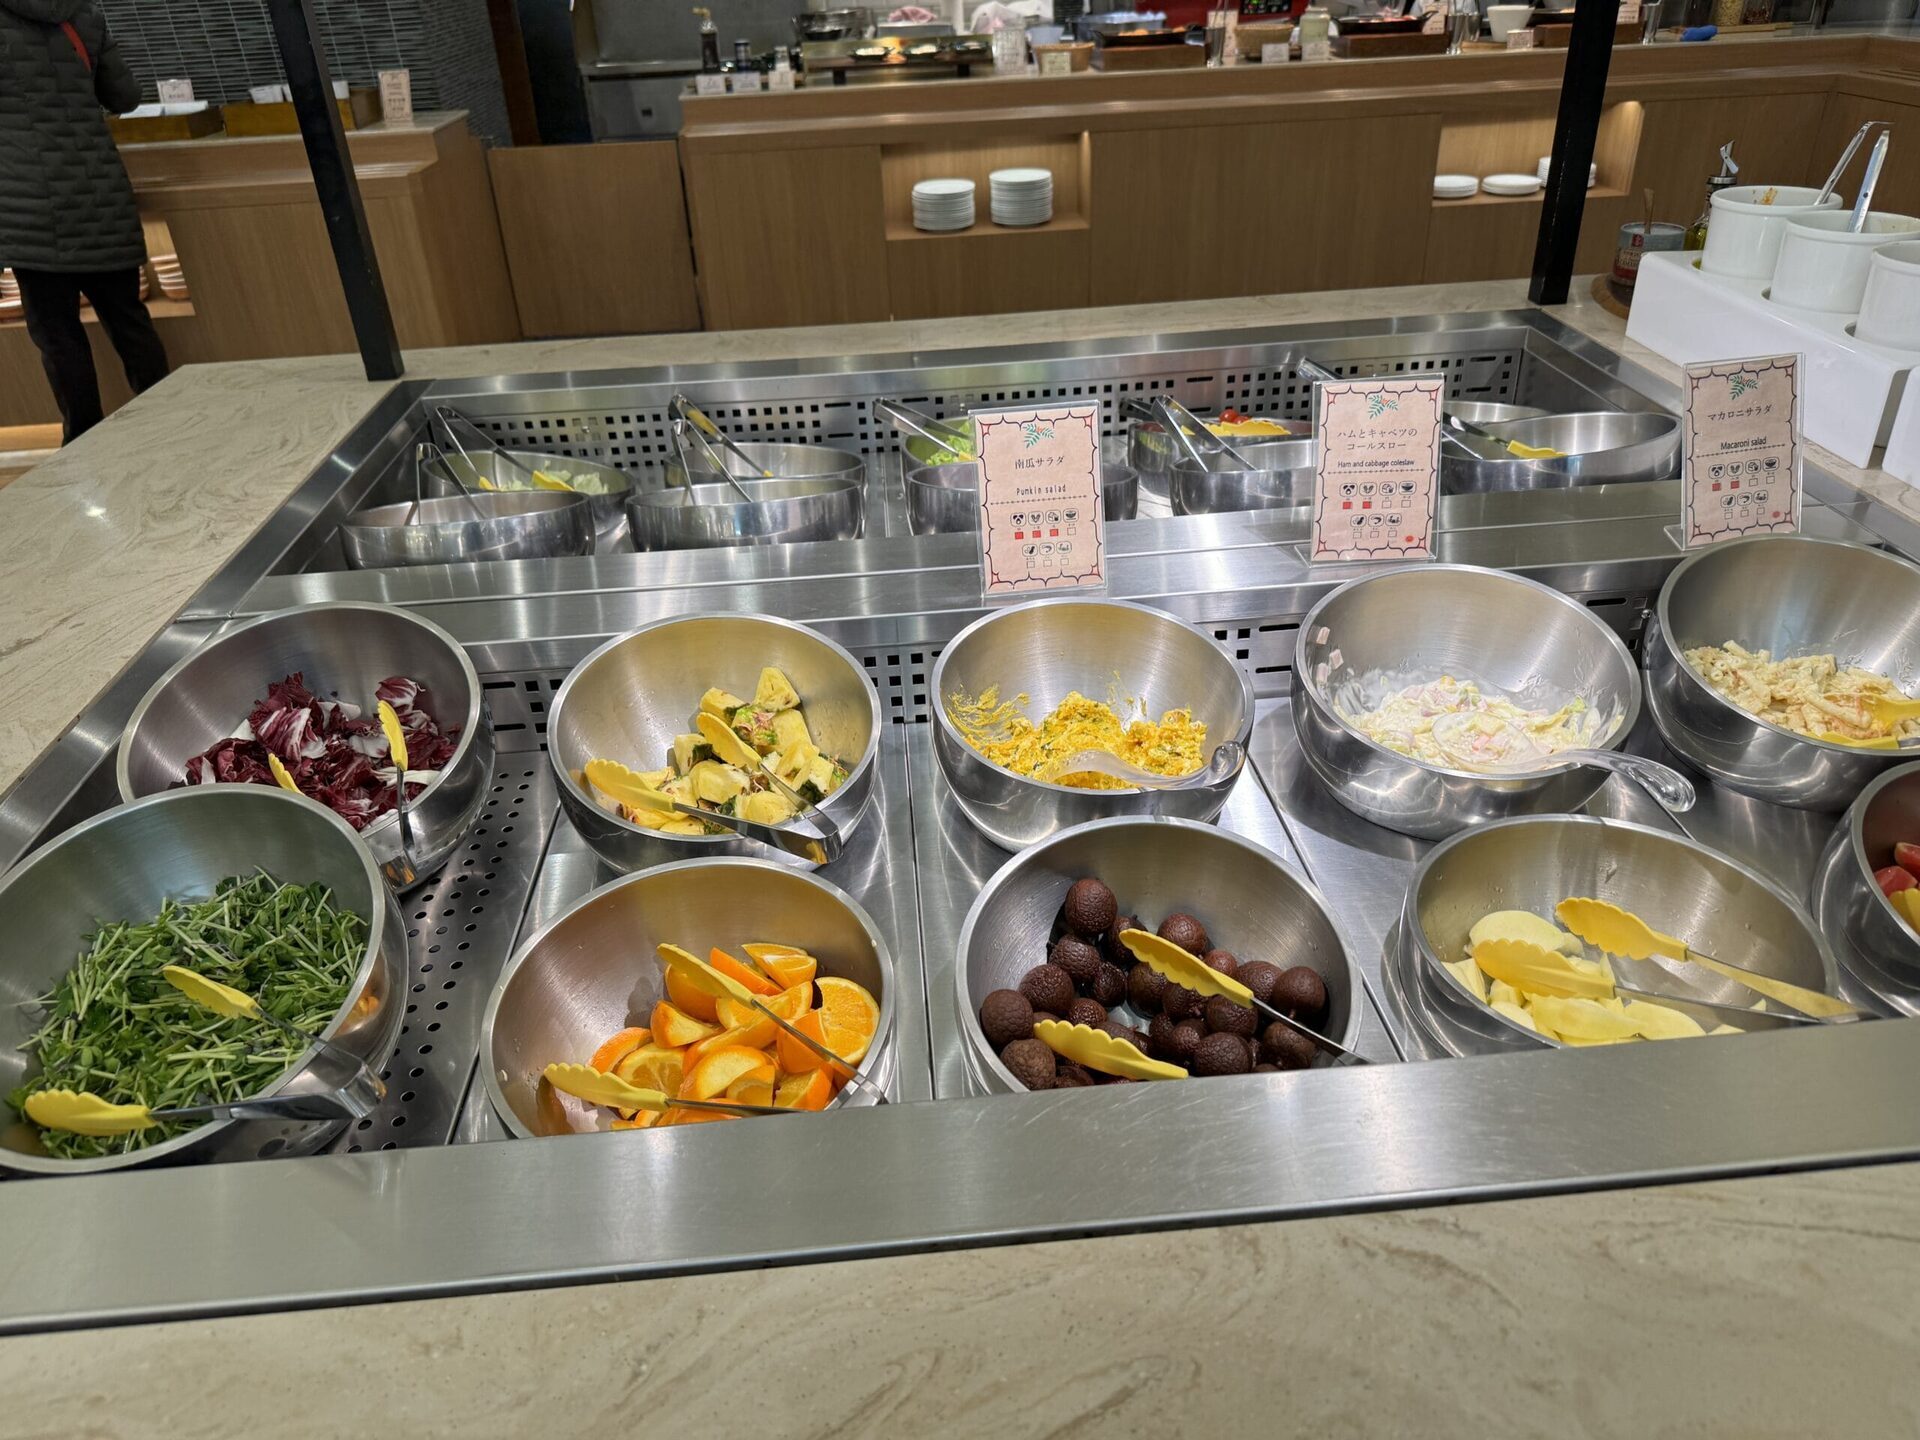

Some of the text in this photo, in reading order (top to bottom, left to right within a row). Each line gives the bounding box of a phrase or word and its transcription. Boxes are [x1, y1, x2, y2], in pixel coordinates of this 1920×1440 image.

[1707, 404, 1772, 421] マカロニサラダ
[1337, 428, 1418, 439] ハムとキャベツの
[1346, 442, 1406, 450] コールスロー
[1720, 436, 1767, 450] Macaroni salad
[1015, 455, 1065, 470] 南瓜サラダ
[1337, 458, 1415, 469] Ham and cabbage coleslaw
[1045, 484, 1066, 494] salad
